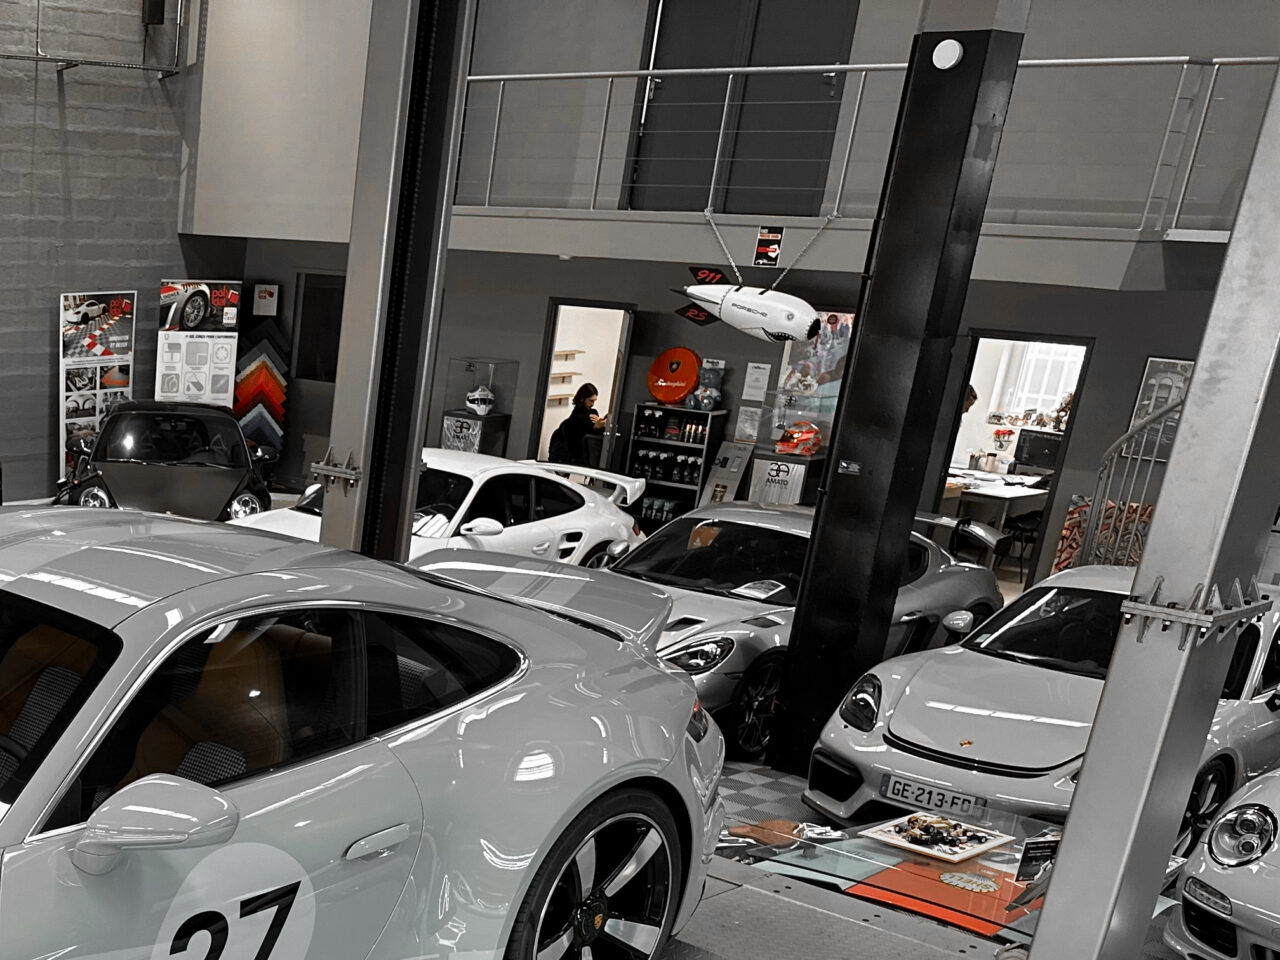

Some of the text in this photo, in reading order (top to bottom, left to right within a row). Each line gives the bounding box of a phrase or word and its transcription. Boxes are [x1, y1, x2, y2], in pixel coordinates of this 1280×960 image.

[696, 269, 722, 283] 911
[685, 309, 708, 321] RS
[731, 302, 769, 318] PORSCHE
[766, 477, 789, 486] AMATO
